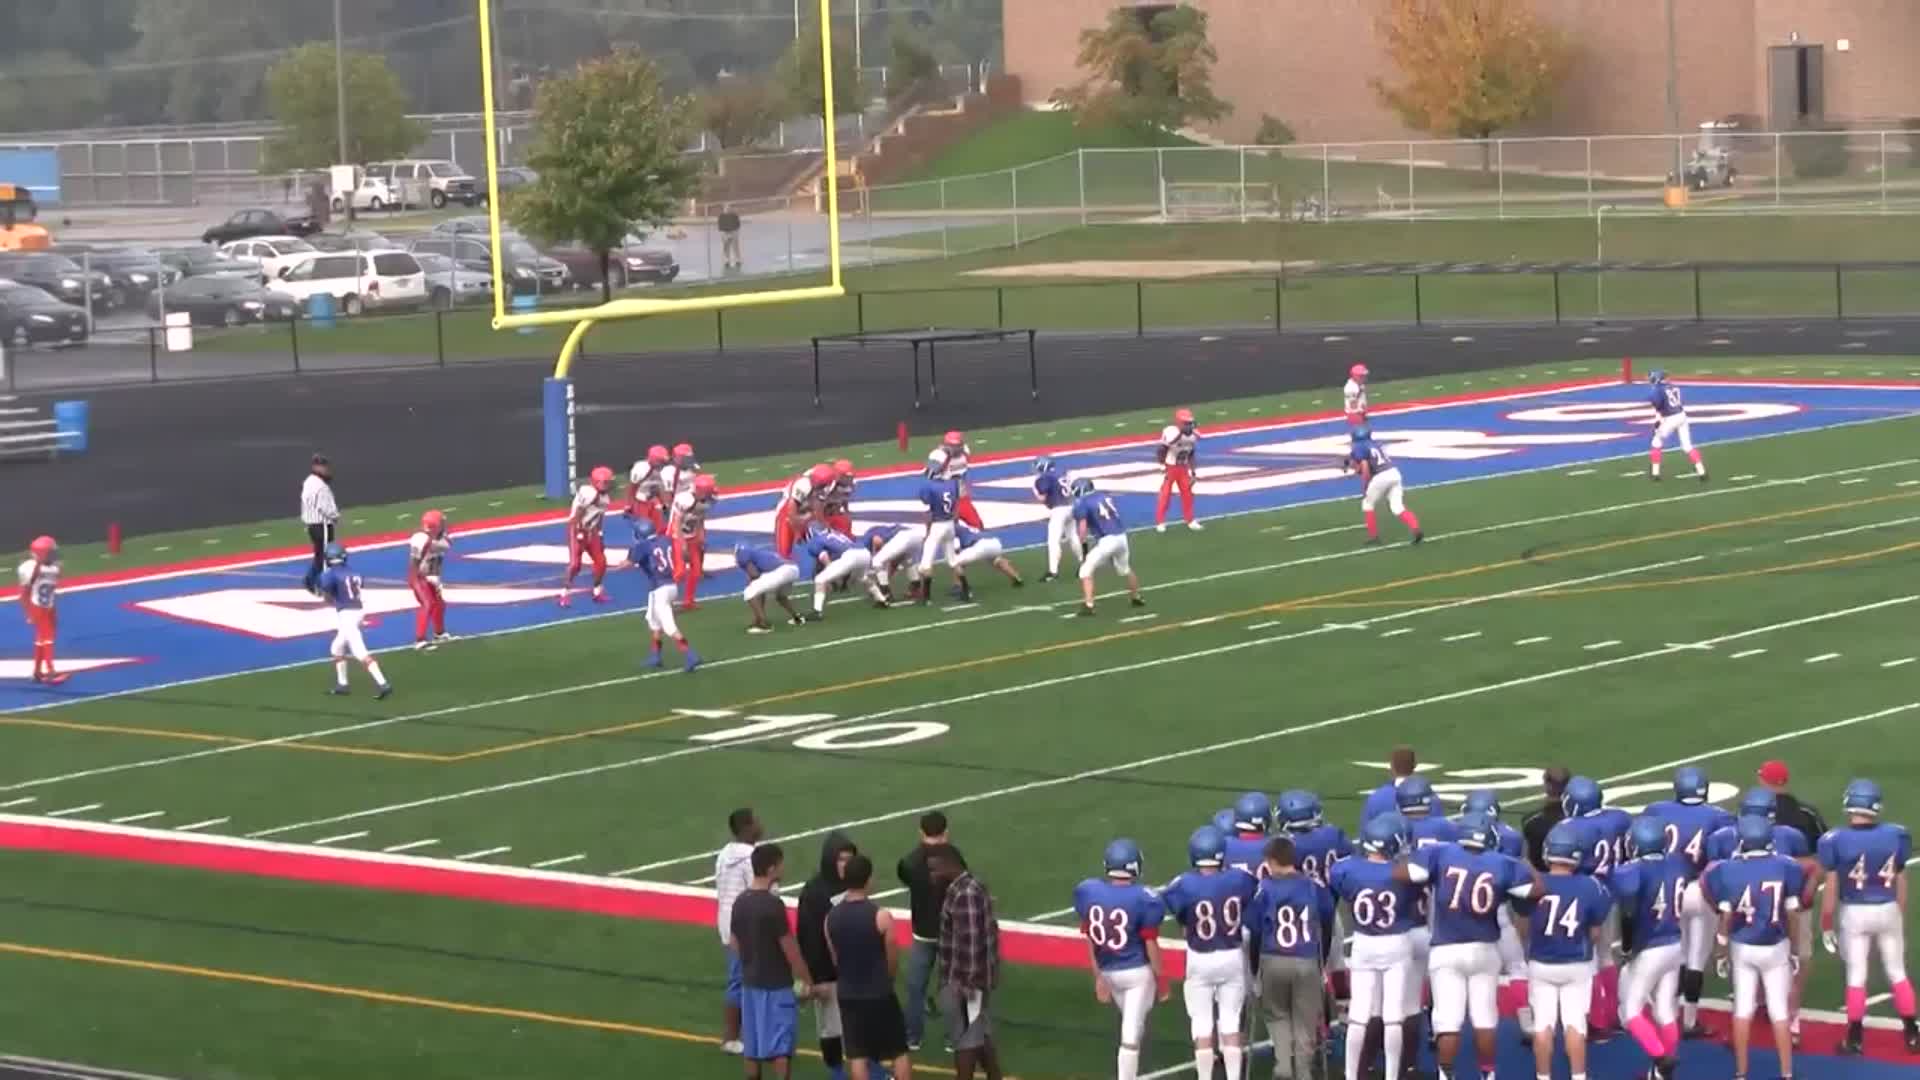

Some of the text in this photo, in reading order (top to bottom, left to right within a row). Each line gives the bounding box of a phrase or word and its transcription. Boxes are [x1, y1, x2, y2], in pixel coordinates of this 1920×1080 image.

[0, 402, 1808, 680] AIDERS
[1664, 823, 1704, 864] 24
[1446, 866, 1495, 915] 76
[1848, 852, 1898, 891] 44
[1195, 896, 1242, 941] 89
[1353, 888, 1397, 928] 63
[1539, 894, 1579, 938] 74
[1735, 880, 1783, 925] 47
[1089, 905, 1129, 950] 83
[1276, 904, 1312, 949] 81
